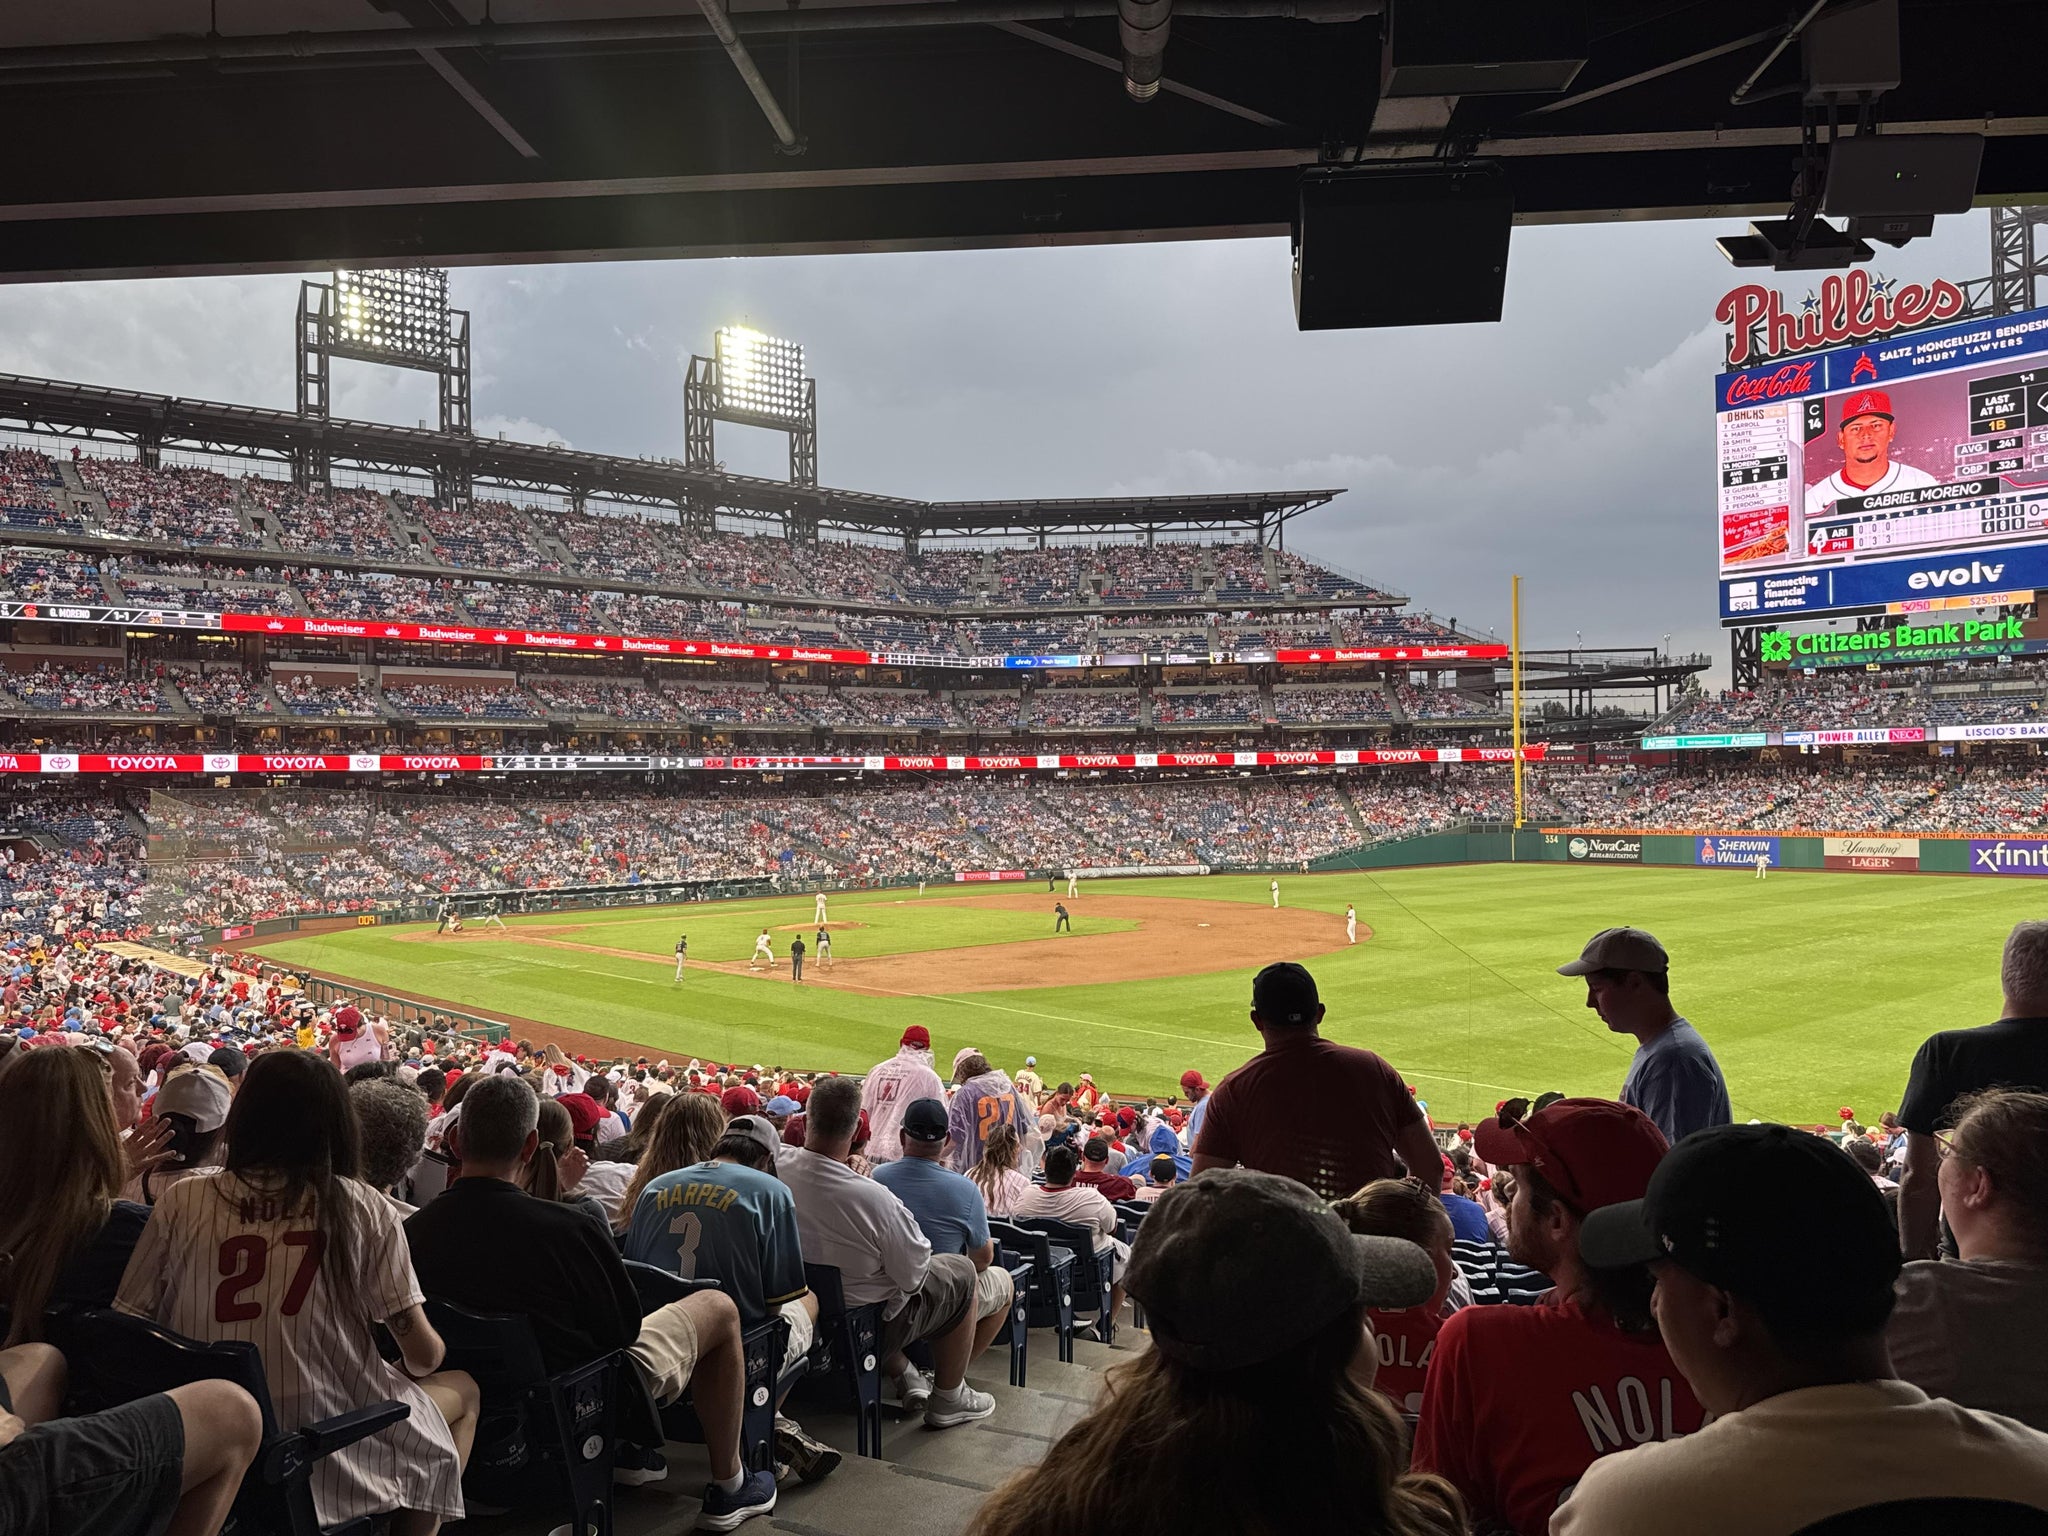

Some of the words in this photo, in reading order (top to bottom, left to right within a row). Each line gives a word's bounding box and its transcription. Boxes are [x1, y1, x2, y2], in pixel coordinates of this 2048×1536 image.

[1715, 269, 1965, 364] Phillies
[1879, 347, 1913, 362] SALTZ
[1916, 330, 1991, 354] MONGELUZZI
[1912, 350, 1957, 366] INJURY
[1965, 337, 2023, 355] LAWYERS
[1726, 361, 1816, 405] Coca-Cola
[2020, 373, 2034, 383] 1-1
[1985, 394, 2010, 406] LAST
[1809, 404, 1820, 416] C
[1979, 406, 1995, 417] AT
[1995, 402, 2015, 414] BAT
[1731, 421, 1760, 429] CARROLL
[1808, 417, 1822, 430] 14
[1988, 420, 2006, 431] 1B
[1731, 445, 1757, 453] NAYLOR
[1961, 444, 1983, 454] AVG
[1996, 438, 2016, 449] .241
[1731, 460, 1760, 468] MORENO
[1962, 465, 1983, 475] OBP
[1996, 459, 2017, 470] .326
[1732, 486, 1758, 494] GURRIEL
[1863, 492, 1917, 509] GABRIEL
[1920, 482, 1982, 501] MORENO
[1732, 493, 1760, 501] THOMAS
[1732, 500, 1765, 509] PERDOMO
[1832, 528, 1848, 538] ARI
[1859, 525, 1863, 534] 0
[1872, 523, 1877, 532] 0
[1886, 522, 1891, 531] 0
[1985, 507, 1991, 519] 0
[2000, 505, 2006, 516] 3
[2015, 503, 2021, 515] 0
[1832, 541, 1848, 550] PHI
[1859, 538, 1864, 547] 0
[1872, 536, 1877, 546] 3
[1886, 535, 1891, 544] 3
[1985, 520, 1992, 532] 6
[2000, 519, 2007, 531] 8
[2015, 517, 2022, 529] 0
[1908, 561, 2004, 590] evolv
[1764, 576, 1818, 589] Connecting
[1764, 586, 1806, 599] financial
[1764, 597, 1806, 609] services.
[59, 608, 91, 619] MORENO
[113, 611, 130, 621] 1-1
[304, 621, 366, 635] Budweiser
[418, 628, 475, 640] Budweiser
[525, 634, 577, 646] Budweiser
[1796, 631, 1891, 655] Citizens
[1896, 621, 1958, 648] Bank
[1963, 615, 2024, 642] Park
[622, 639, 670, 652] Budweiser
[711, 645, 755, 657] Budweiser
[792, 650, 832, 660] Budweiser
[1335, 651, 1381, 660] Budweiser
[1422, 649, 1469, 657] Budweiser
[1818, 732, 1854, 742] POWER
[1857, 730, 1886, 741] ALLEY
[1890, 730, 1921, 740] NECA
[1965, 727, 2016, 737] LISCIO'S
[1174, 754, 1218, 764] TOYOTA
[1274, 752, 1319, 762] TOYOTA
[1376, 751, 1421, 761] TOYOTA
[1479, 749, 1525, 759] TOYOA
[107, 757, 177, 769] TOYOTA
[263, 757, 326, 769] TOYOTA
[403, 757, 460, 768] TOYOTA
[660, 757, 684, 768] 0-2
[898, 758, 934, 768] TOYOTA
[978, 757, 1021, 768] TOYOTA
[1076, 756, 1119, 766] TOYOTA
[1589, 839, 1640, 852] NovaCare
[1718, 839, 1770, 852] SHERWIN
[1841, 840, 1901, 855] Yuengling
[1851, 857, 1890, 867] LAGER
[977, 1093, 1016, 1141] 27
[656, 1183, 739, 1213] HARPER
[239, 1197, 316, 1225] NOLA
[669, 1212, 702, 1280] 3
[215, 1230, 326, 1323] 27
[1376, 1333, 1436, 1369] OLA
[1571, 1376, 1714, 1453] NOL
